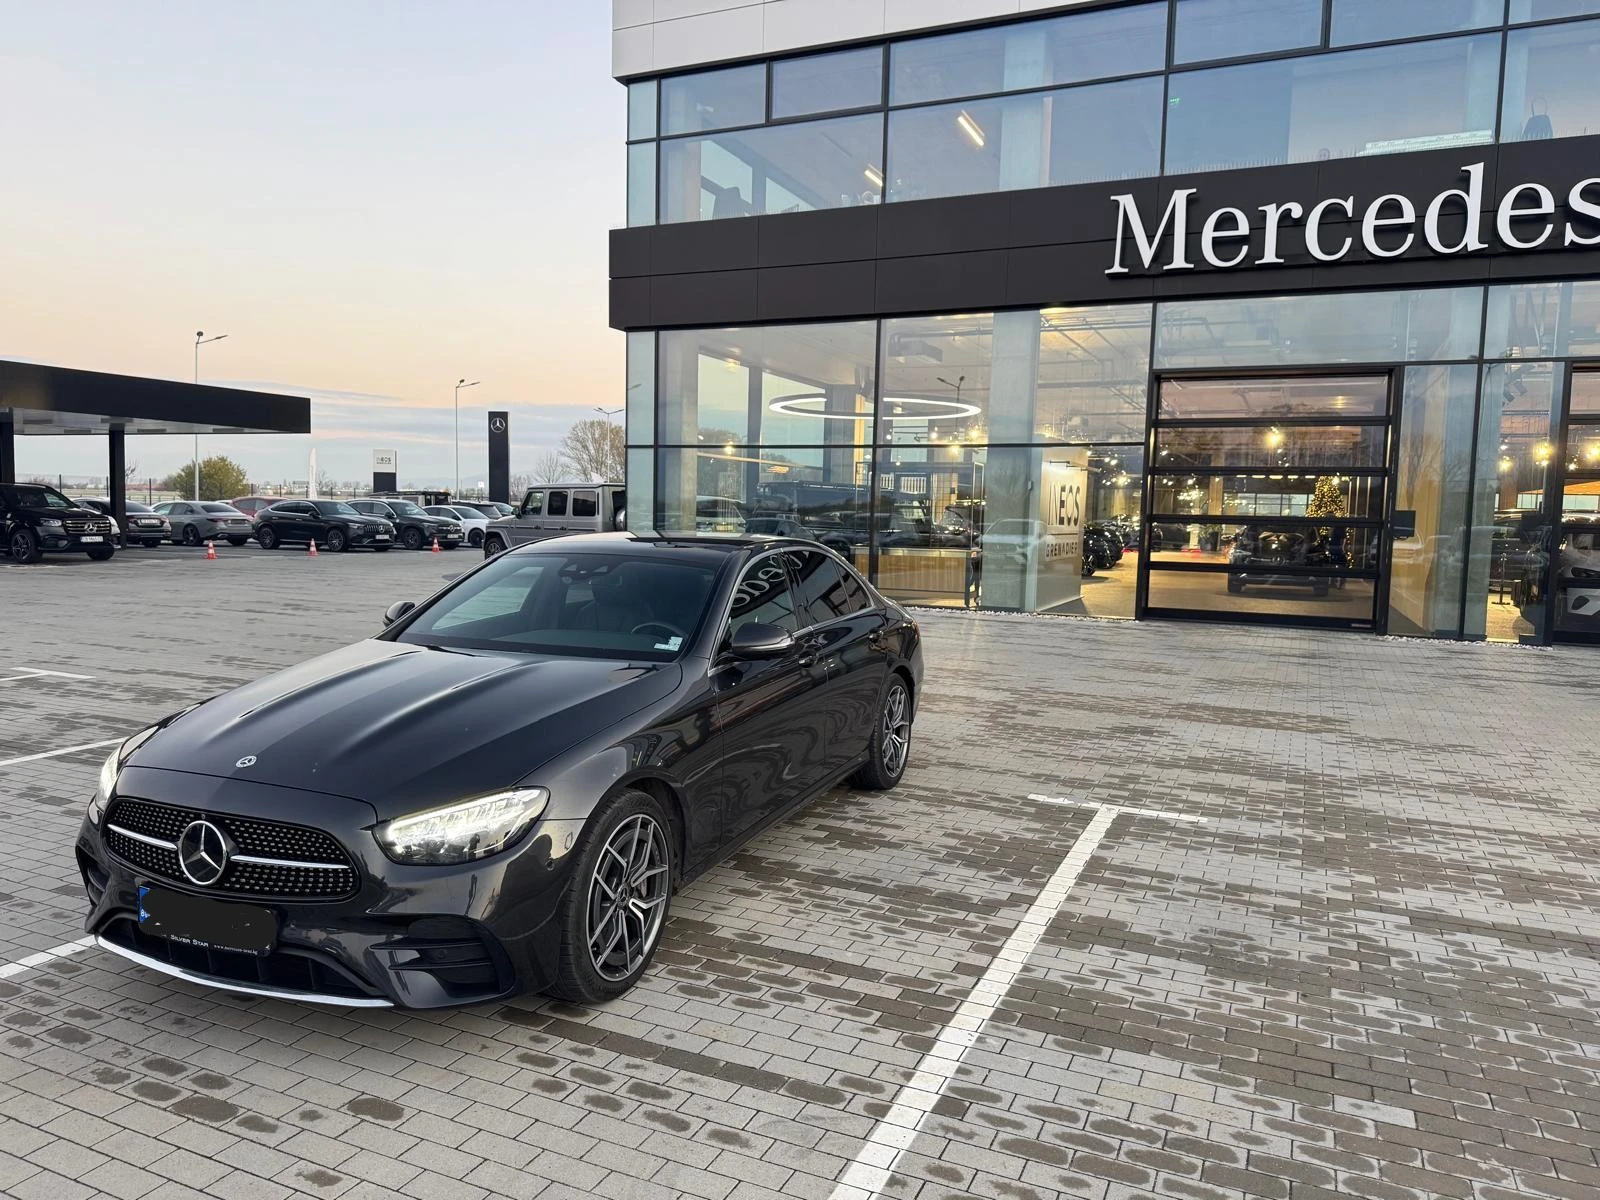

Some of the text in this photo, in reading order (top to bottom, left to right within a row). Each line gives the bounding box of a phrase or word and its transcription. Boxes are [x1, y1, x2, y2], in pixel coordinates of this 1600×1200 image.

[1104, 161, 1600, 275] Mercedes
[1047, 483, 1080, 526] INEOS
[1046, 542, 1078, 557] GRENADIER
[170, 934, 209, 948] SILVER STAR
